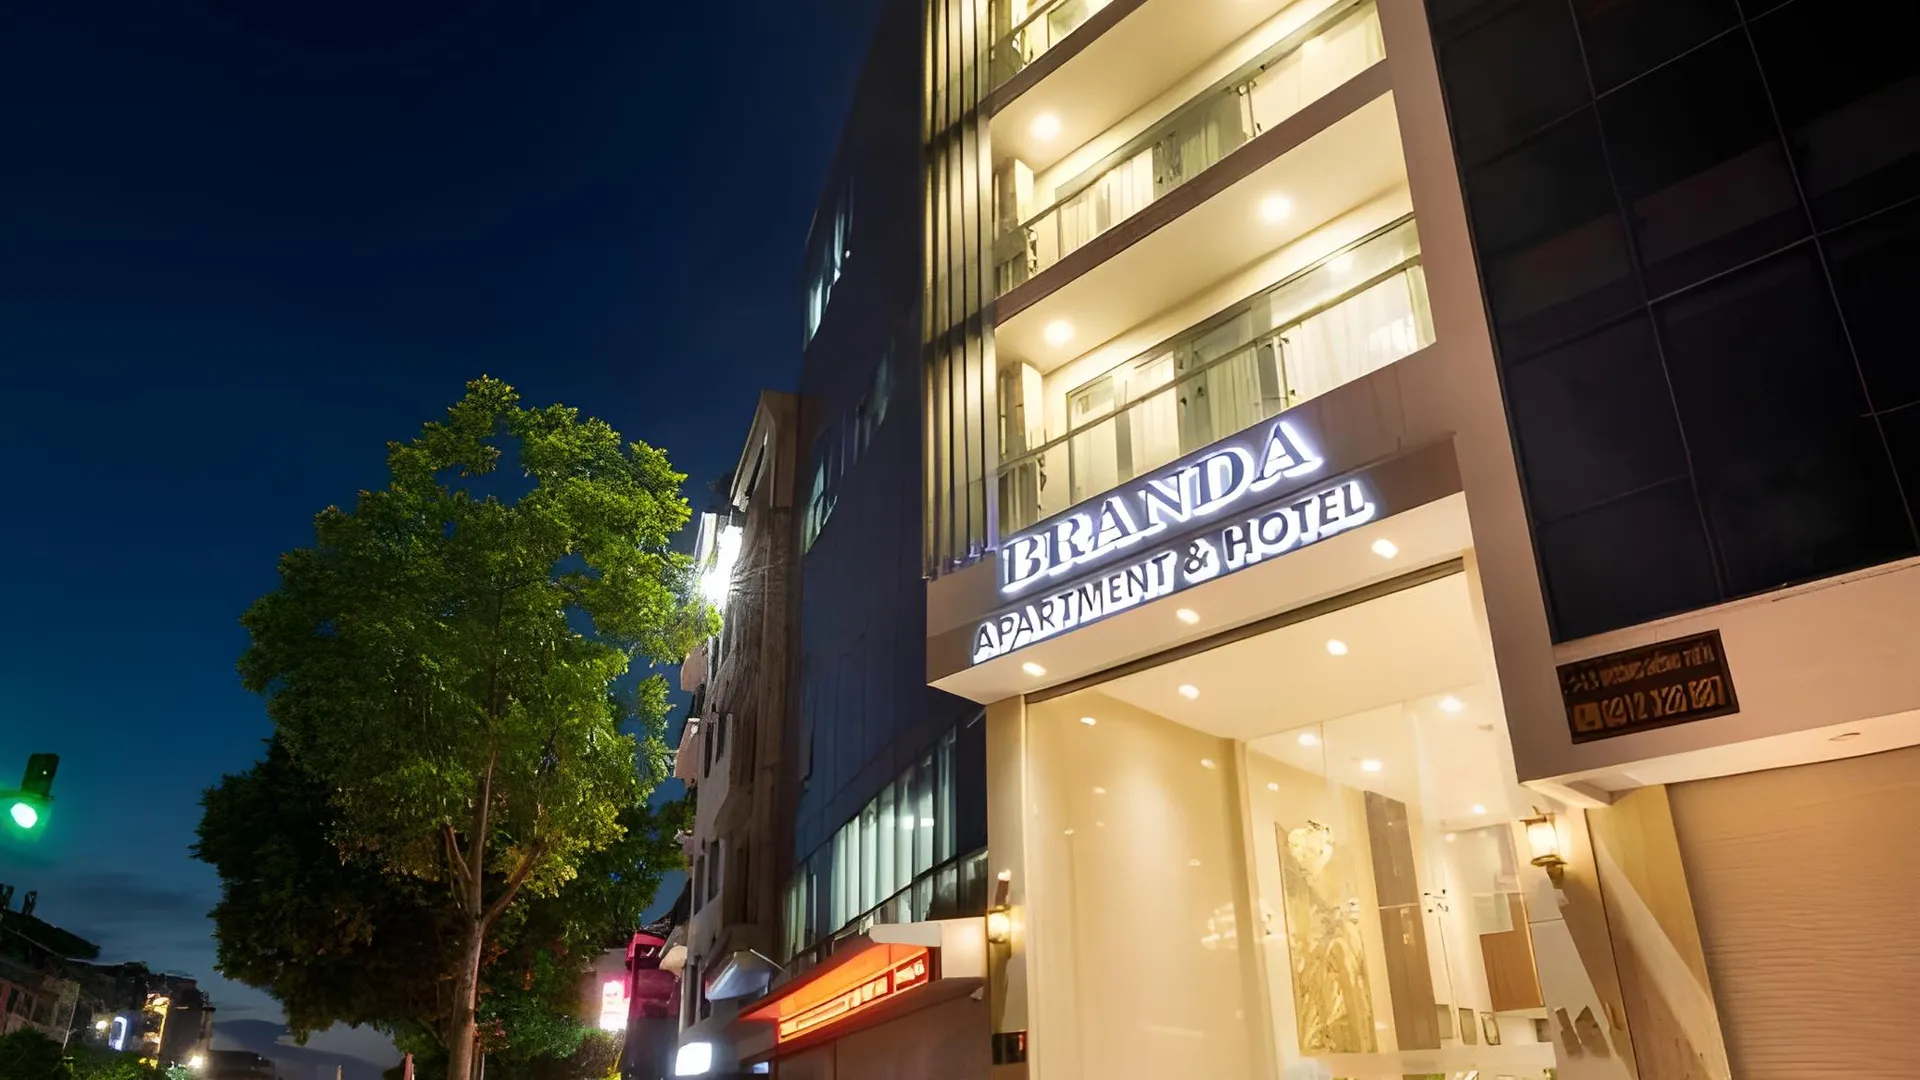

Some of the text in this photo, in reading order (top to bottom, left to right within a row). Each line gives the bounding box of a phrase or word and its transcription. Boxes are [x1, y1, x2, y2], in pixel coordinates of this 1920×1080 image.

[973, 482, 1371, 660] APARTMENT & HOTEL
[1003, 421, 1320, 591] BRANDA
